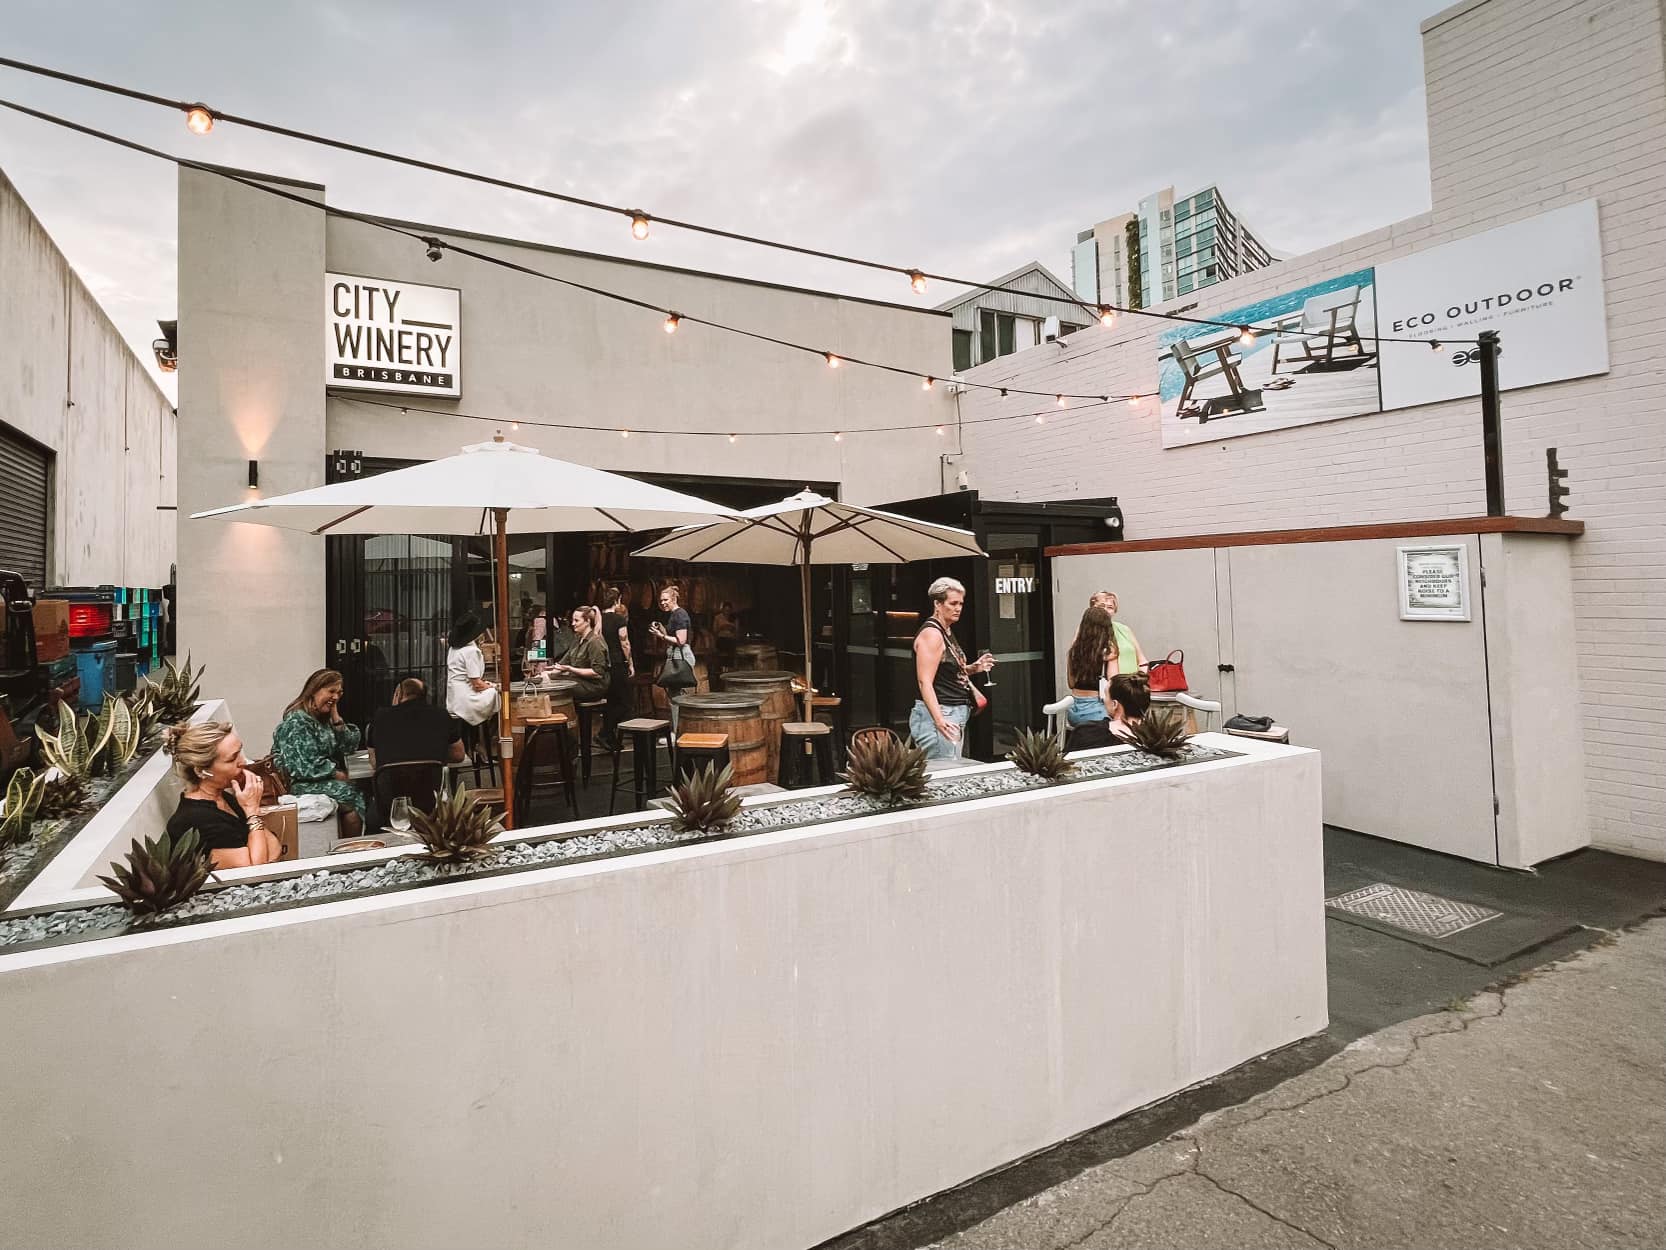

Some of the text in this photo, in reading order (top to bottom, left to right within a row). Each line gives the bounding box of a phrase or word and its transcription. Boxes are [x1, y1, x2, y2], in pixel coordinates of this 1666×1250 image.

[333, 282, 400, 323] CITY
[1393, 279, 1574, 332] ECO OUTDOOR
[333, 322, 452, 368] WINERY
[342, 367, 445, 385] BRISBANE
[995, 577, 1033, 594] ENTRY
